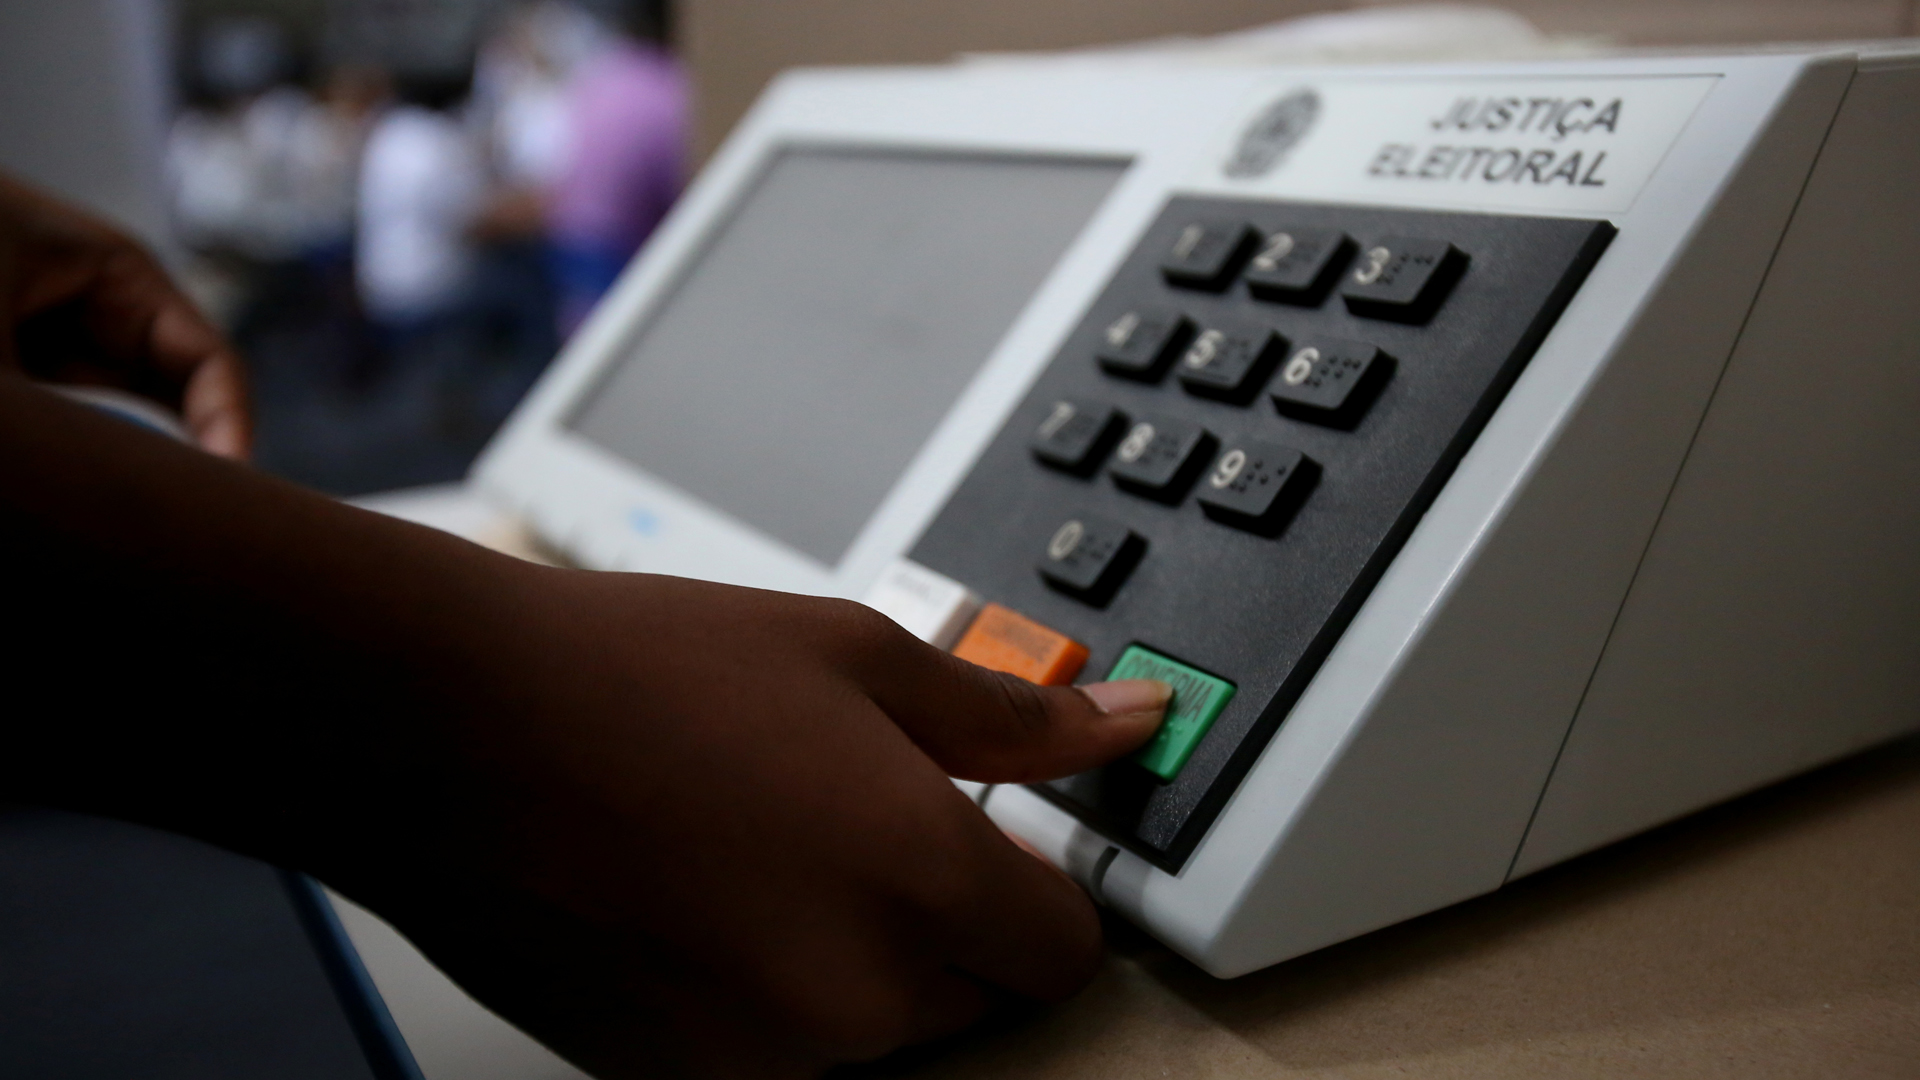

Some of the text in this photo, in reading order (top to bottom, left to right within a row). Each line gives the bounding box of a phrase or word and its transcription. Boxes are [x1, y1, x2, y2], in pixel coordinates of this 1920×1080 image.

[1430, 96, 1623, 141] JUSTIÇA
[1368, 144, 1607, 187] ELEITORAL
[1172, 225, 1201, 260] 1
[1253, 233, 1293, 270] 2
[1354, 247, 1391, 285] 3
[1106, 312, 1139, 346] 4
[1185, 330, 1225, 368] 5
[1284, 347, 1320, 384] 6
[1039, 402, 1074, 438] 7
[1117, 422, 1155, 462] 8
[1211, 450, 1246, 488] 9
